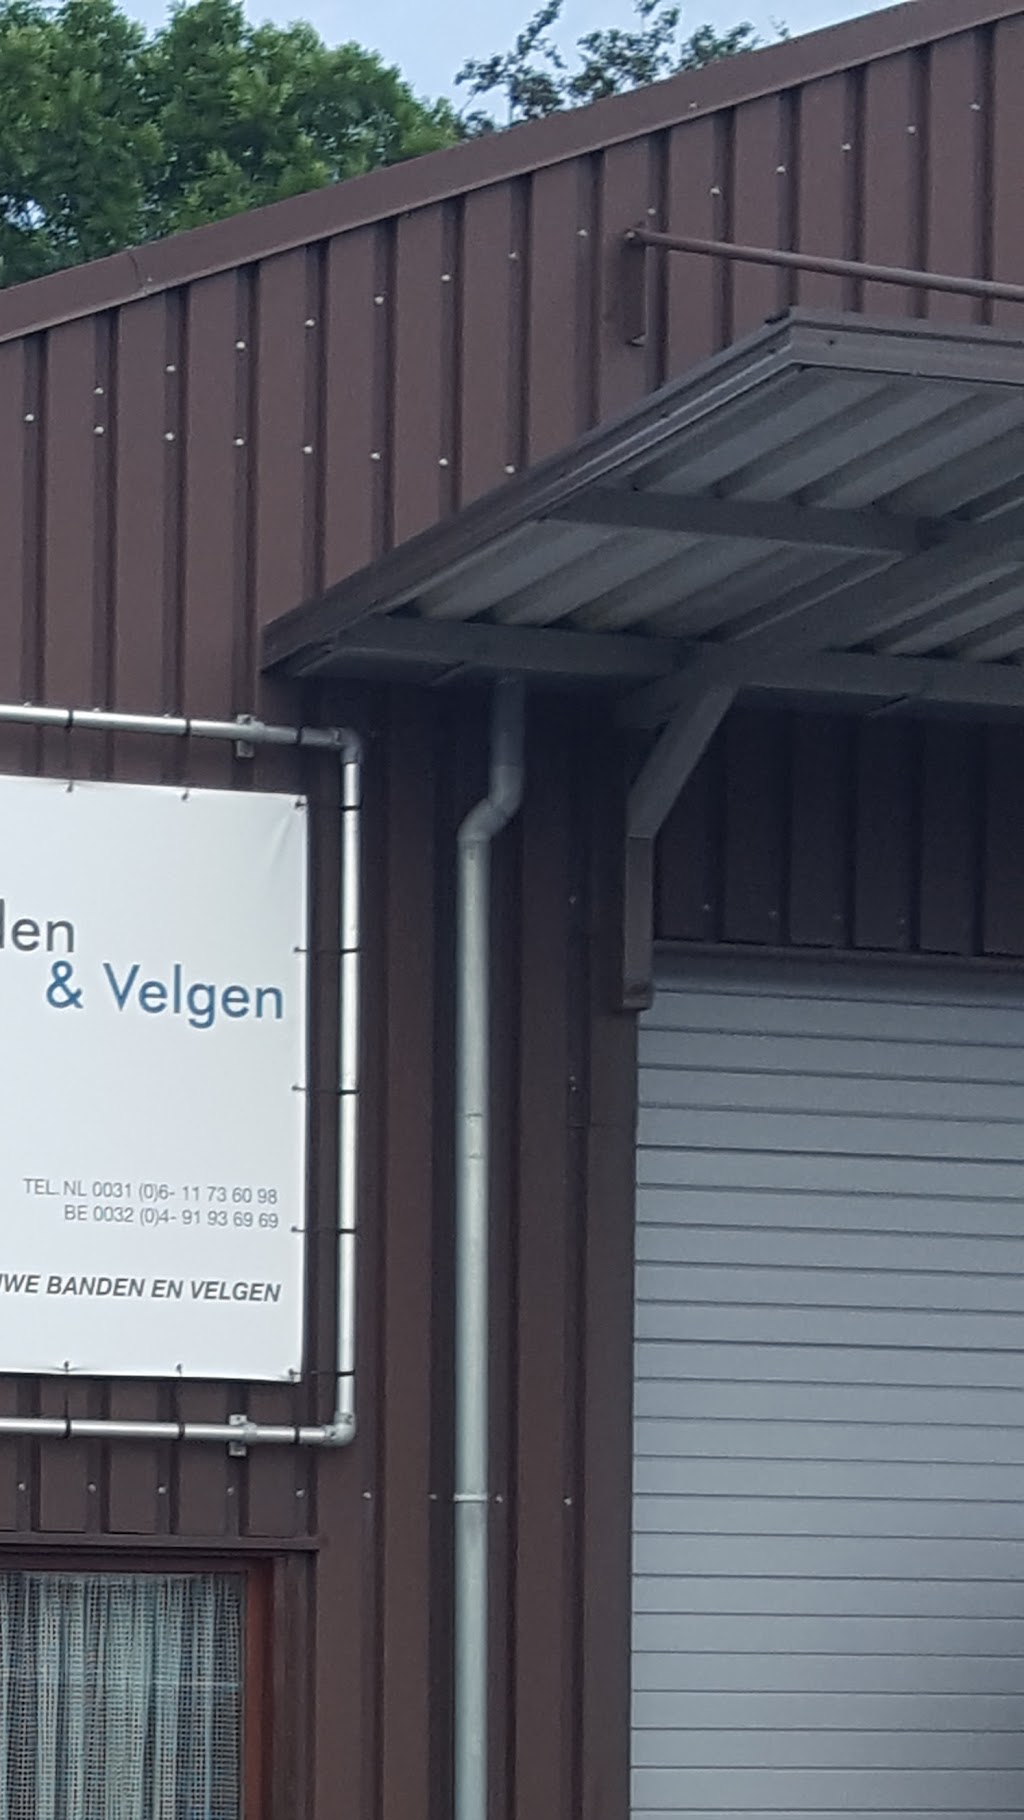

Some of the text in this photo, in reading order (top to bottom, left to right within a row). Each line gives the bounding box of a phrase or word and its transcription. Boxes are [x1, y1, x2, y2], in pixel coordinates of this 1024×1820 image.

[46, 962, 283, 1028] & Velgen
[92, 1181, 132, 1199] 0031
[138, 1183, 175, 1203] (0)6-
[182, 1186, 201, 1201] 11
[207, 1186, 227, 1202] 73
[232, 1188, 252, 1204] 60
[257, 1189, 278, 1205] 98
[64, 1205, 279, 1229] BE 0032 (0)4- 91 93 69 69
[46, 1276, 145, 1299] BANDEN
[151, 1279, 184, 1299] EN
[190, 1280, 282, 1303] VELGEN
